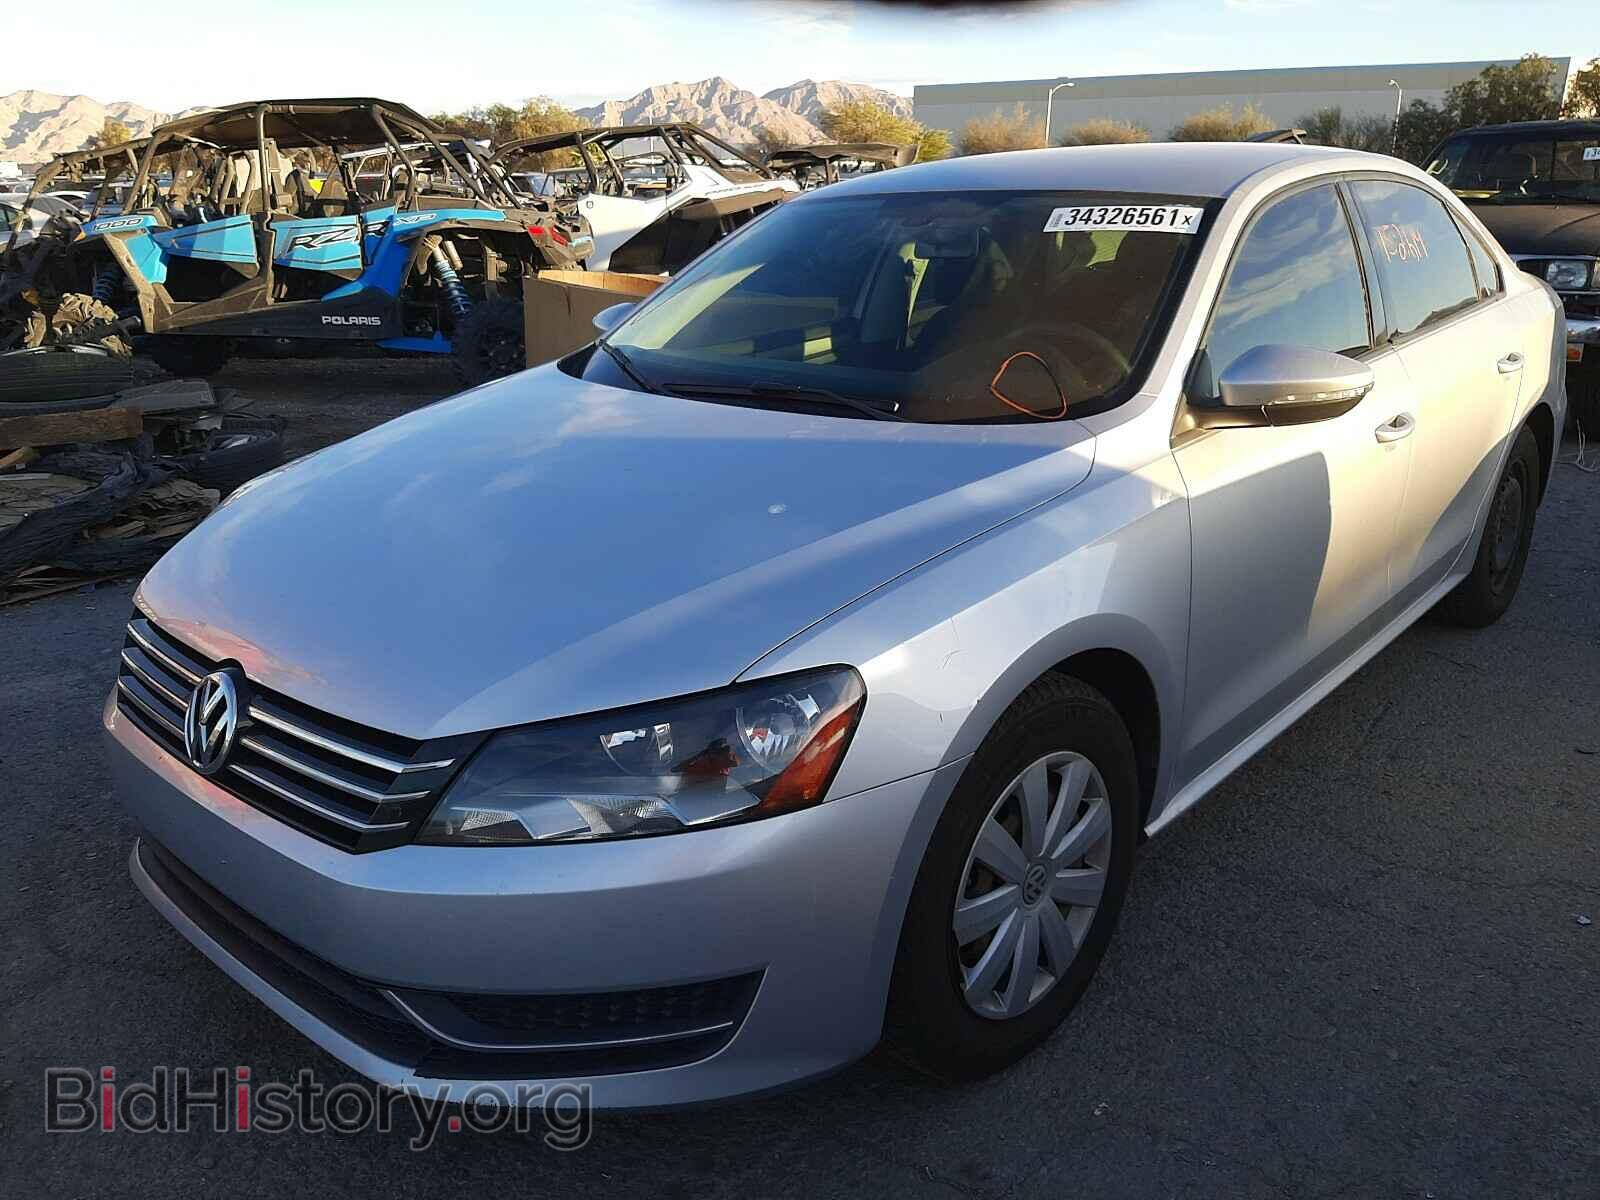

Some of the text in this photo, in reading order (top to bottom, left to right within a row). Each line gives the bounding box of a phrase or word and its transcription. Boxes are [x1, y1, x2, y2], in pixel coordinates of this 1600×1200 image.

[1065, 207, 1179, 226] 34326561
[94, 218, 143, 231] 1000
[321, 315, 382, 326] POLARIS
